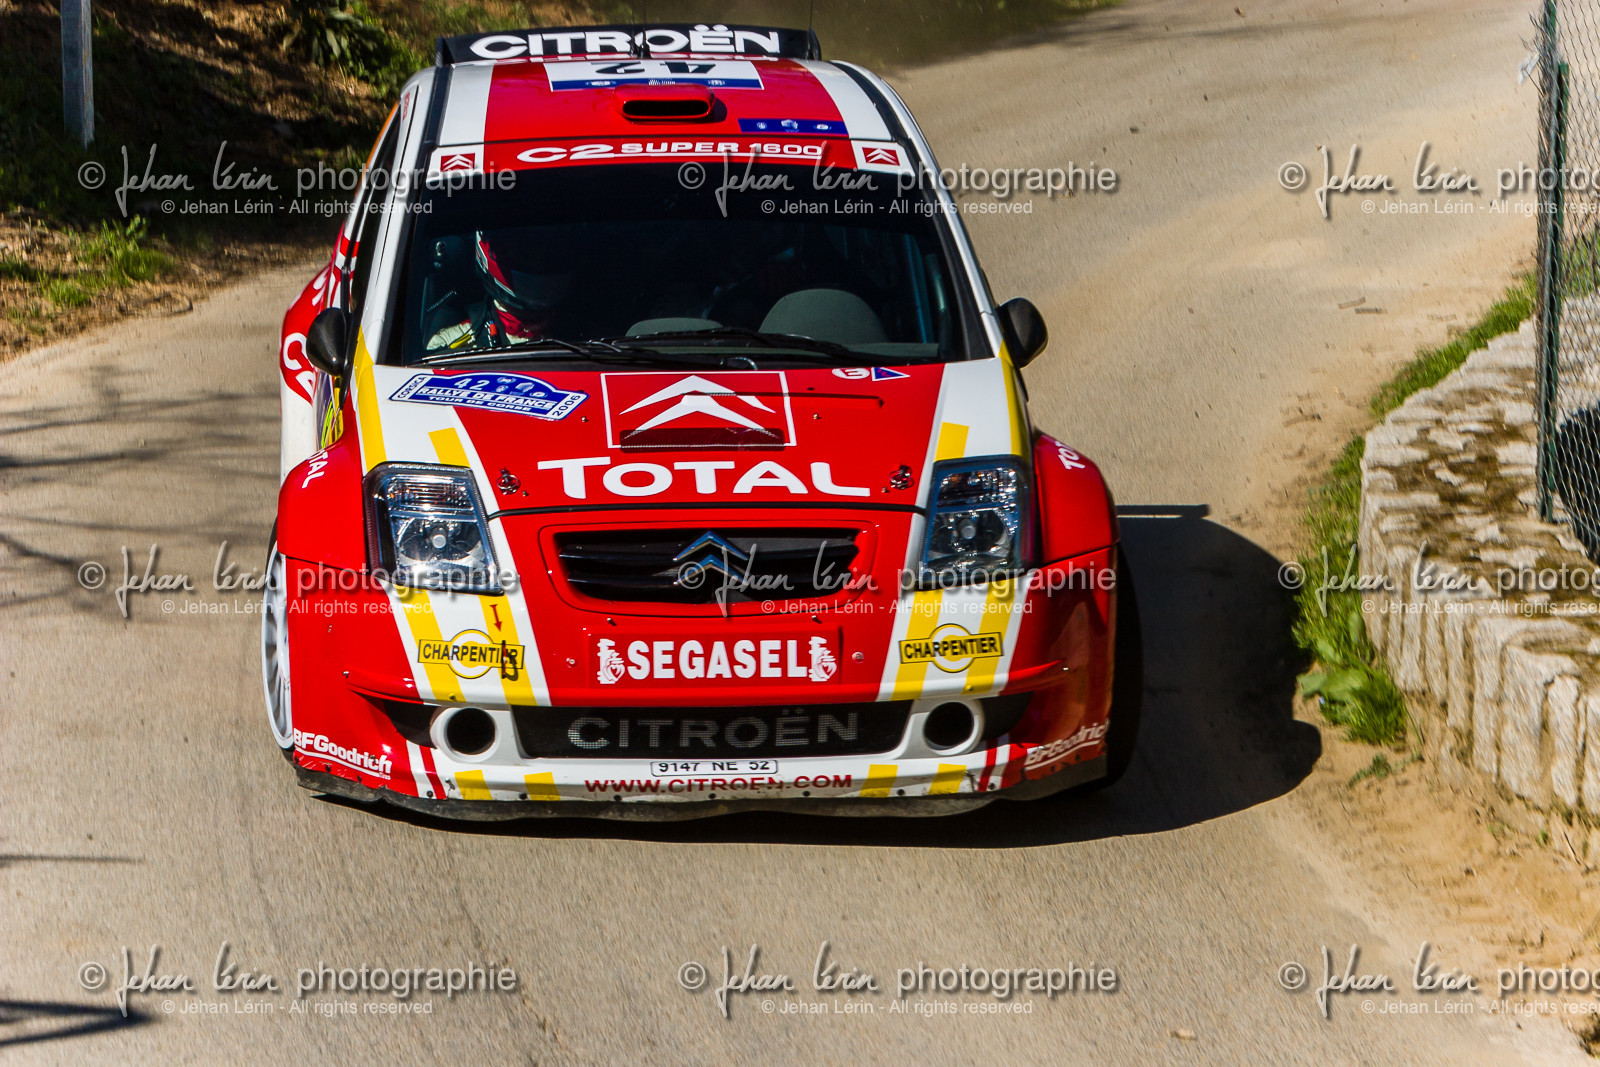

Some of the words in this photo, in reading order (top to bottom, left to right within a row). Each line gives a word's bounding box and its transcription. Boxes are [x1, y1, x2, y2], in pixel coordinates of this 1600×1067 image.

[470, 24, 780, 60] CITROËN
[517, 144, 614, 162] C2
[621, 142, 739, 154] SUPER
[749, 143, 823, 155] 1600
[454, 378, 490, 391] 42
[416, 386, 471, 400] RALLYE
[472, 391, 496, 403] DE
[494, 394, 556, 411] FRANCE
[487, 402, 532, 412] CORSE
[552, 395, 581, 416] 2006
[537, 456, 870, 499] TOTAL
[422, 643, 518, 665] CHARPENTIER
[904, 633, 1000, 658] CHARPENTIER
[626, 639, 809, 680] SEGASEL
[567, 707, 859, 750] CITROËN
[293, 727, 393, 774] BFGoodrich
[658, 761, 700, 772] 9147
[712, 761, 739, 771] NE
[749, 760, 770, 771] 52
[584, 774, 852, 794] WWW.CITROEN.COM
